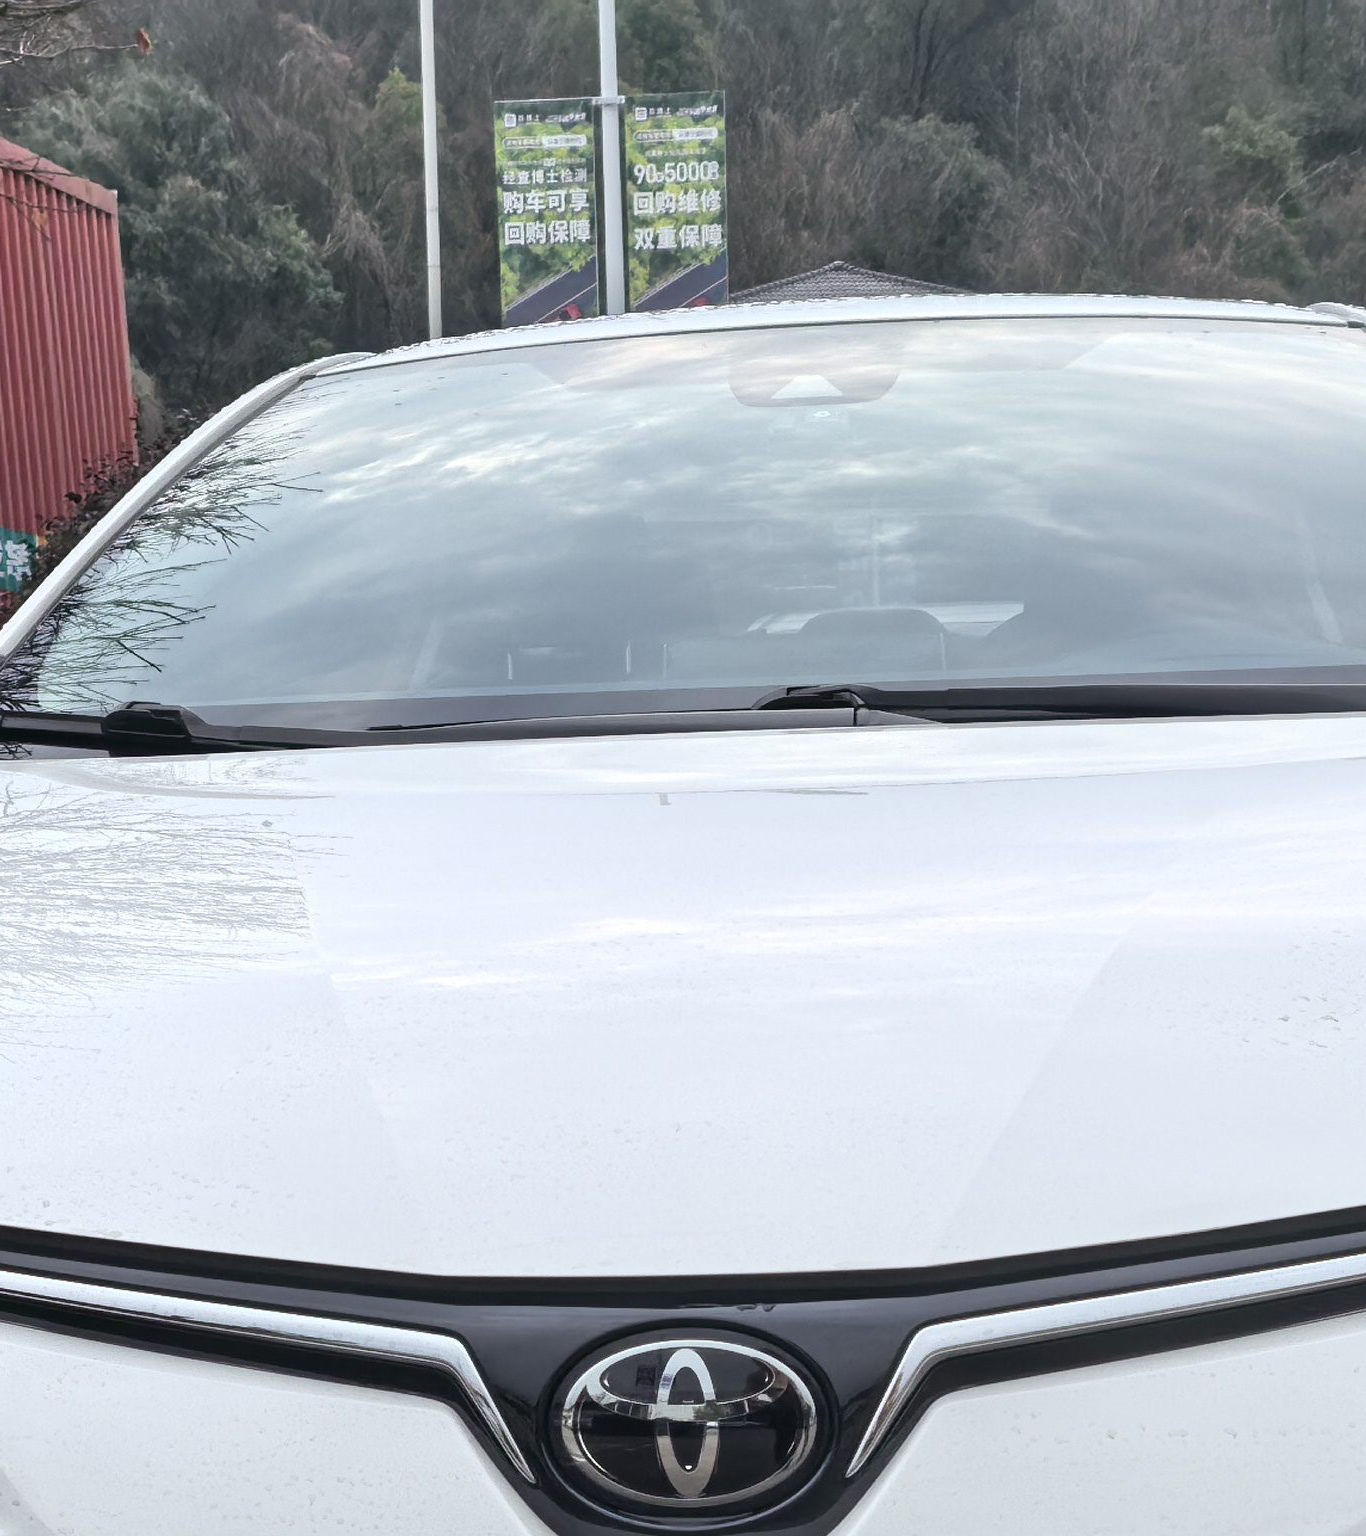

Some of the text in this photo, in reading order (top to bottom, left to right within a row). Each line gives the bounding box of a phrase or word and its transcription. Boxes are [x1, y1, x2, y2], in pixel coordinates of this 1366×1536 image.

[503, 188, 590, 215] 购车可享
[633, 188, 722, 216] 回购维修
[504, 219, 592, 246] 回购保障
[634, 224, 723, 250] 双重保障
